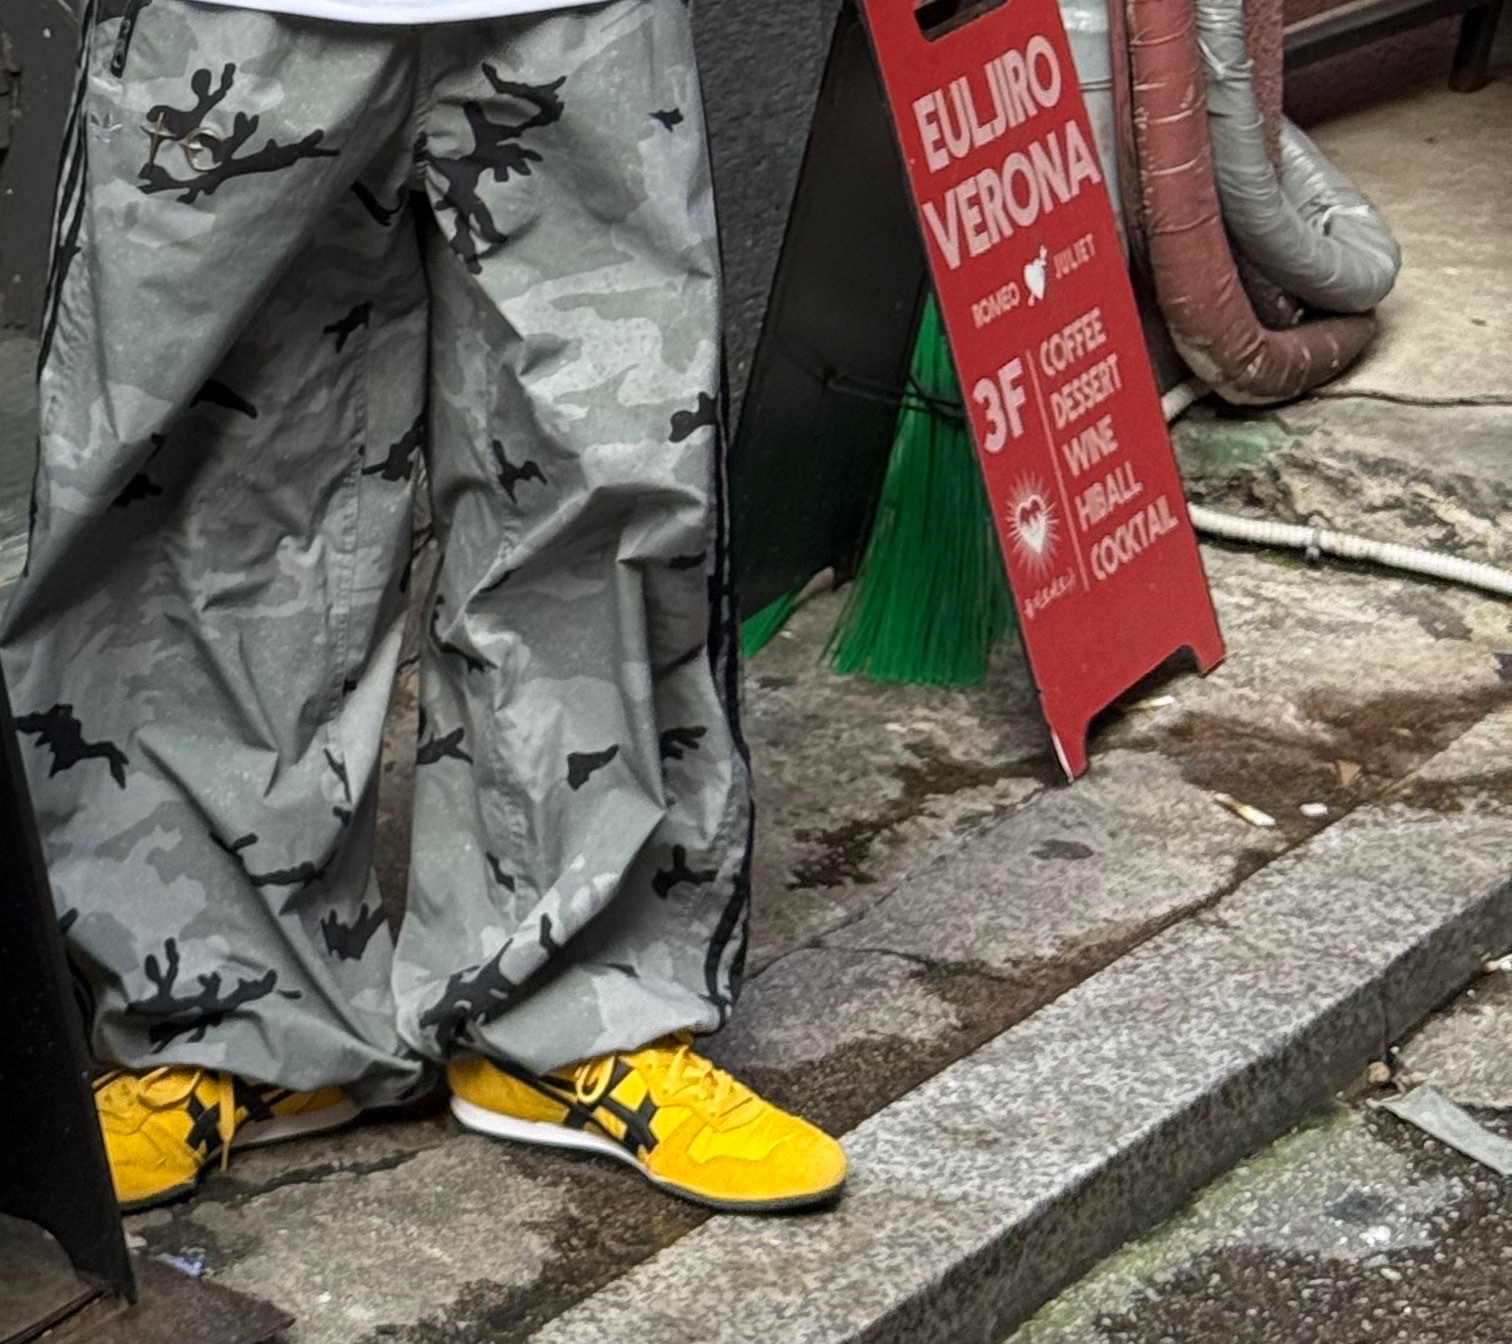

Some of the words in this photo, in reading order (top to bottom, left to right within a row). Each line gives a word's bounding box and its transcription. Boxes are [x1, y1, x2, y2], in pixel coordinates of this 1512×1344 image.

[912, 35, 1062, 173] EULJIRO
[922, 119, 1101, 270] VERONA
[971, 281, 1021, 329] ROMEO
[1053, 233, 1096, 279] JULIET
[1040, 307, 1108, 377] COFFEE
[972, 357, 1026, 453] 3F
[1050, 353, 1122, 430] DESSERT
[1062, 413, 1118, 477] WINE
[1090, 494, 1179, 581] COCKTAIL
